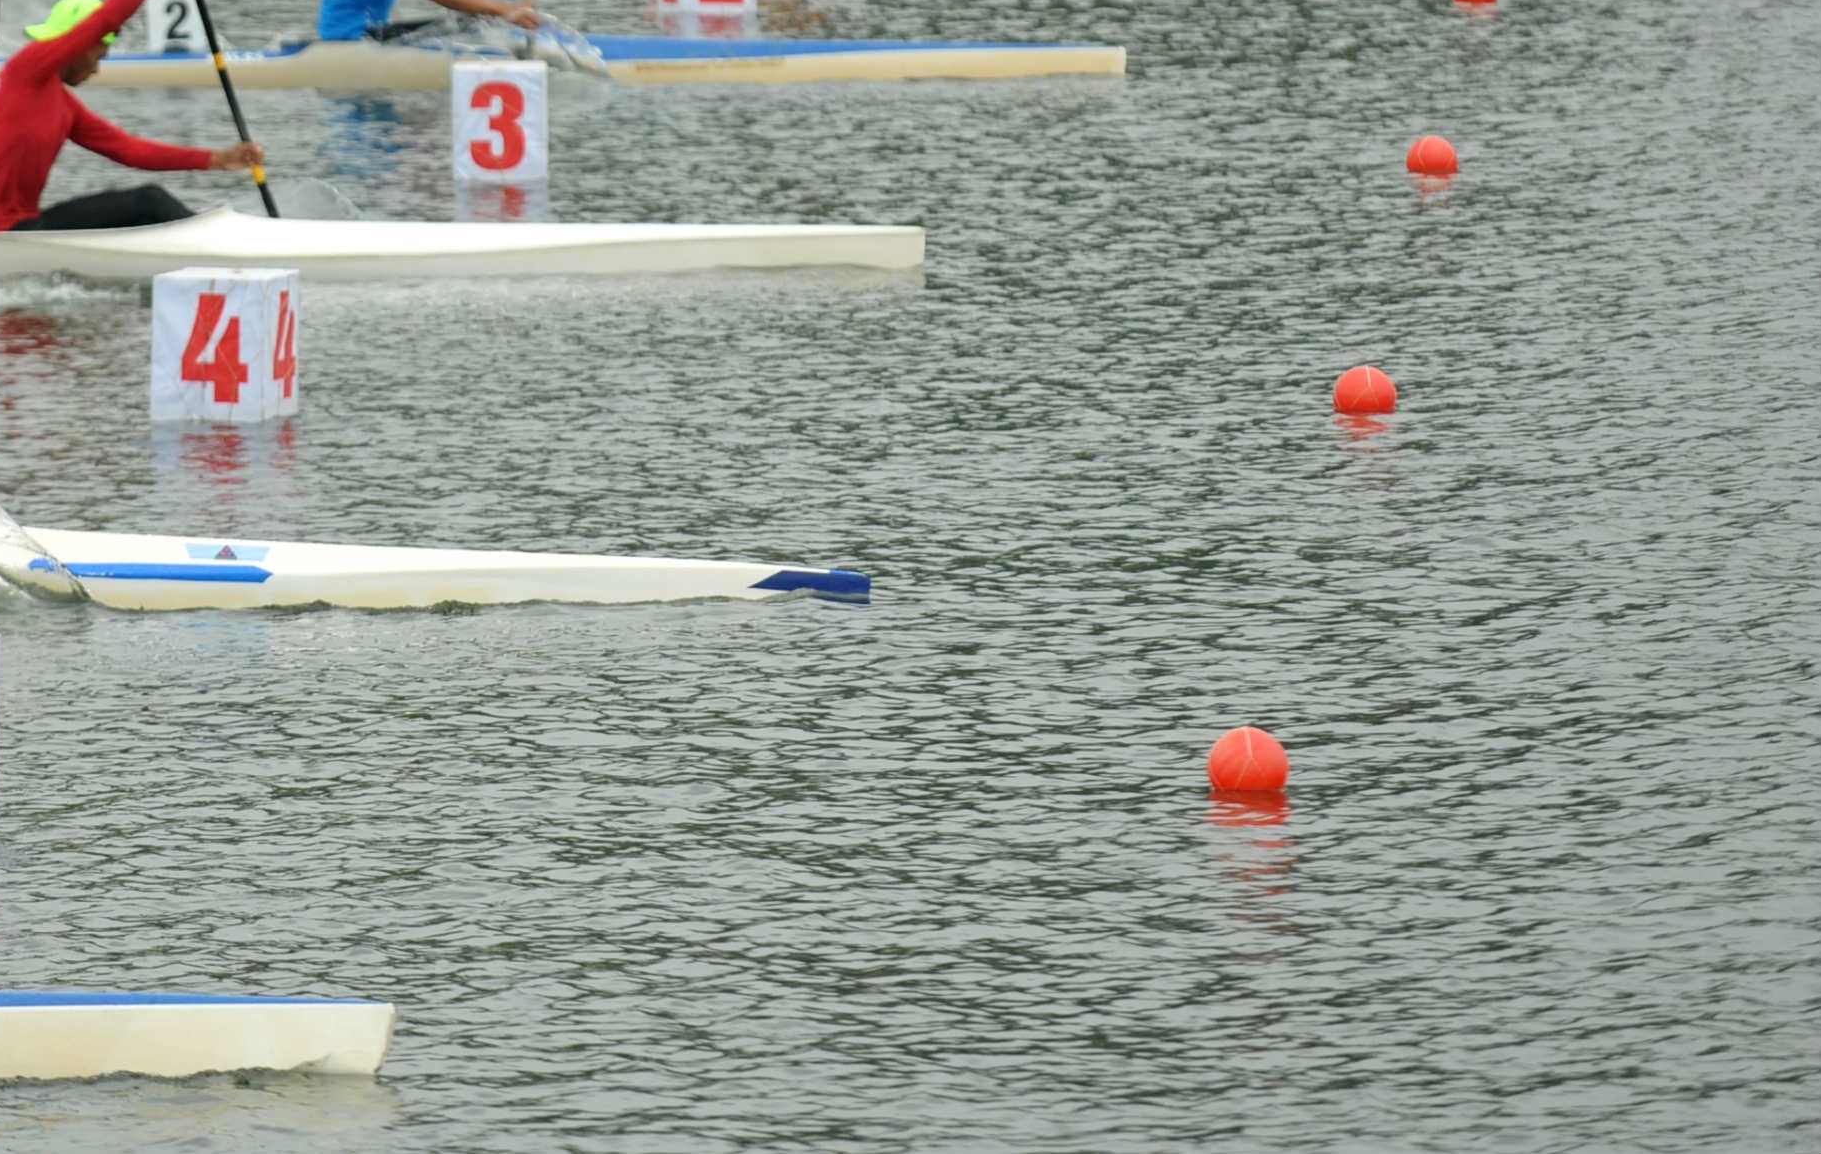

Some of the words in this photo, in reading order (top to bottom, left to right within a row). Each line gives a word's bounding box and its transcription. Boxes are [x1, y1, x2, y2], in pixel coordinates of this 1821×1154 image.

[166, 0, 190, 39] 2
[470, 80, 527, 171] 3
[181, 293, 249, 404] 4
[273, 290, 296, 399] 4
